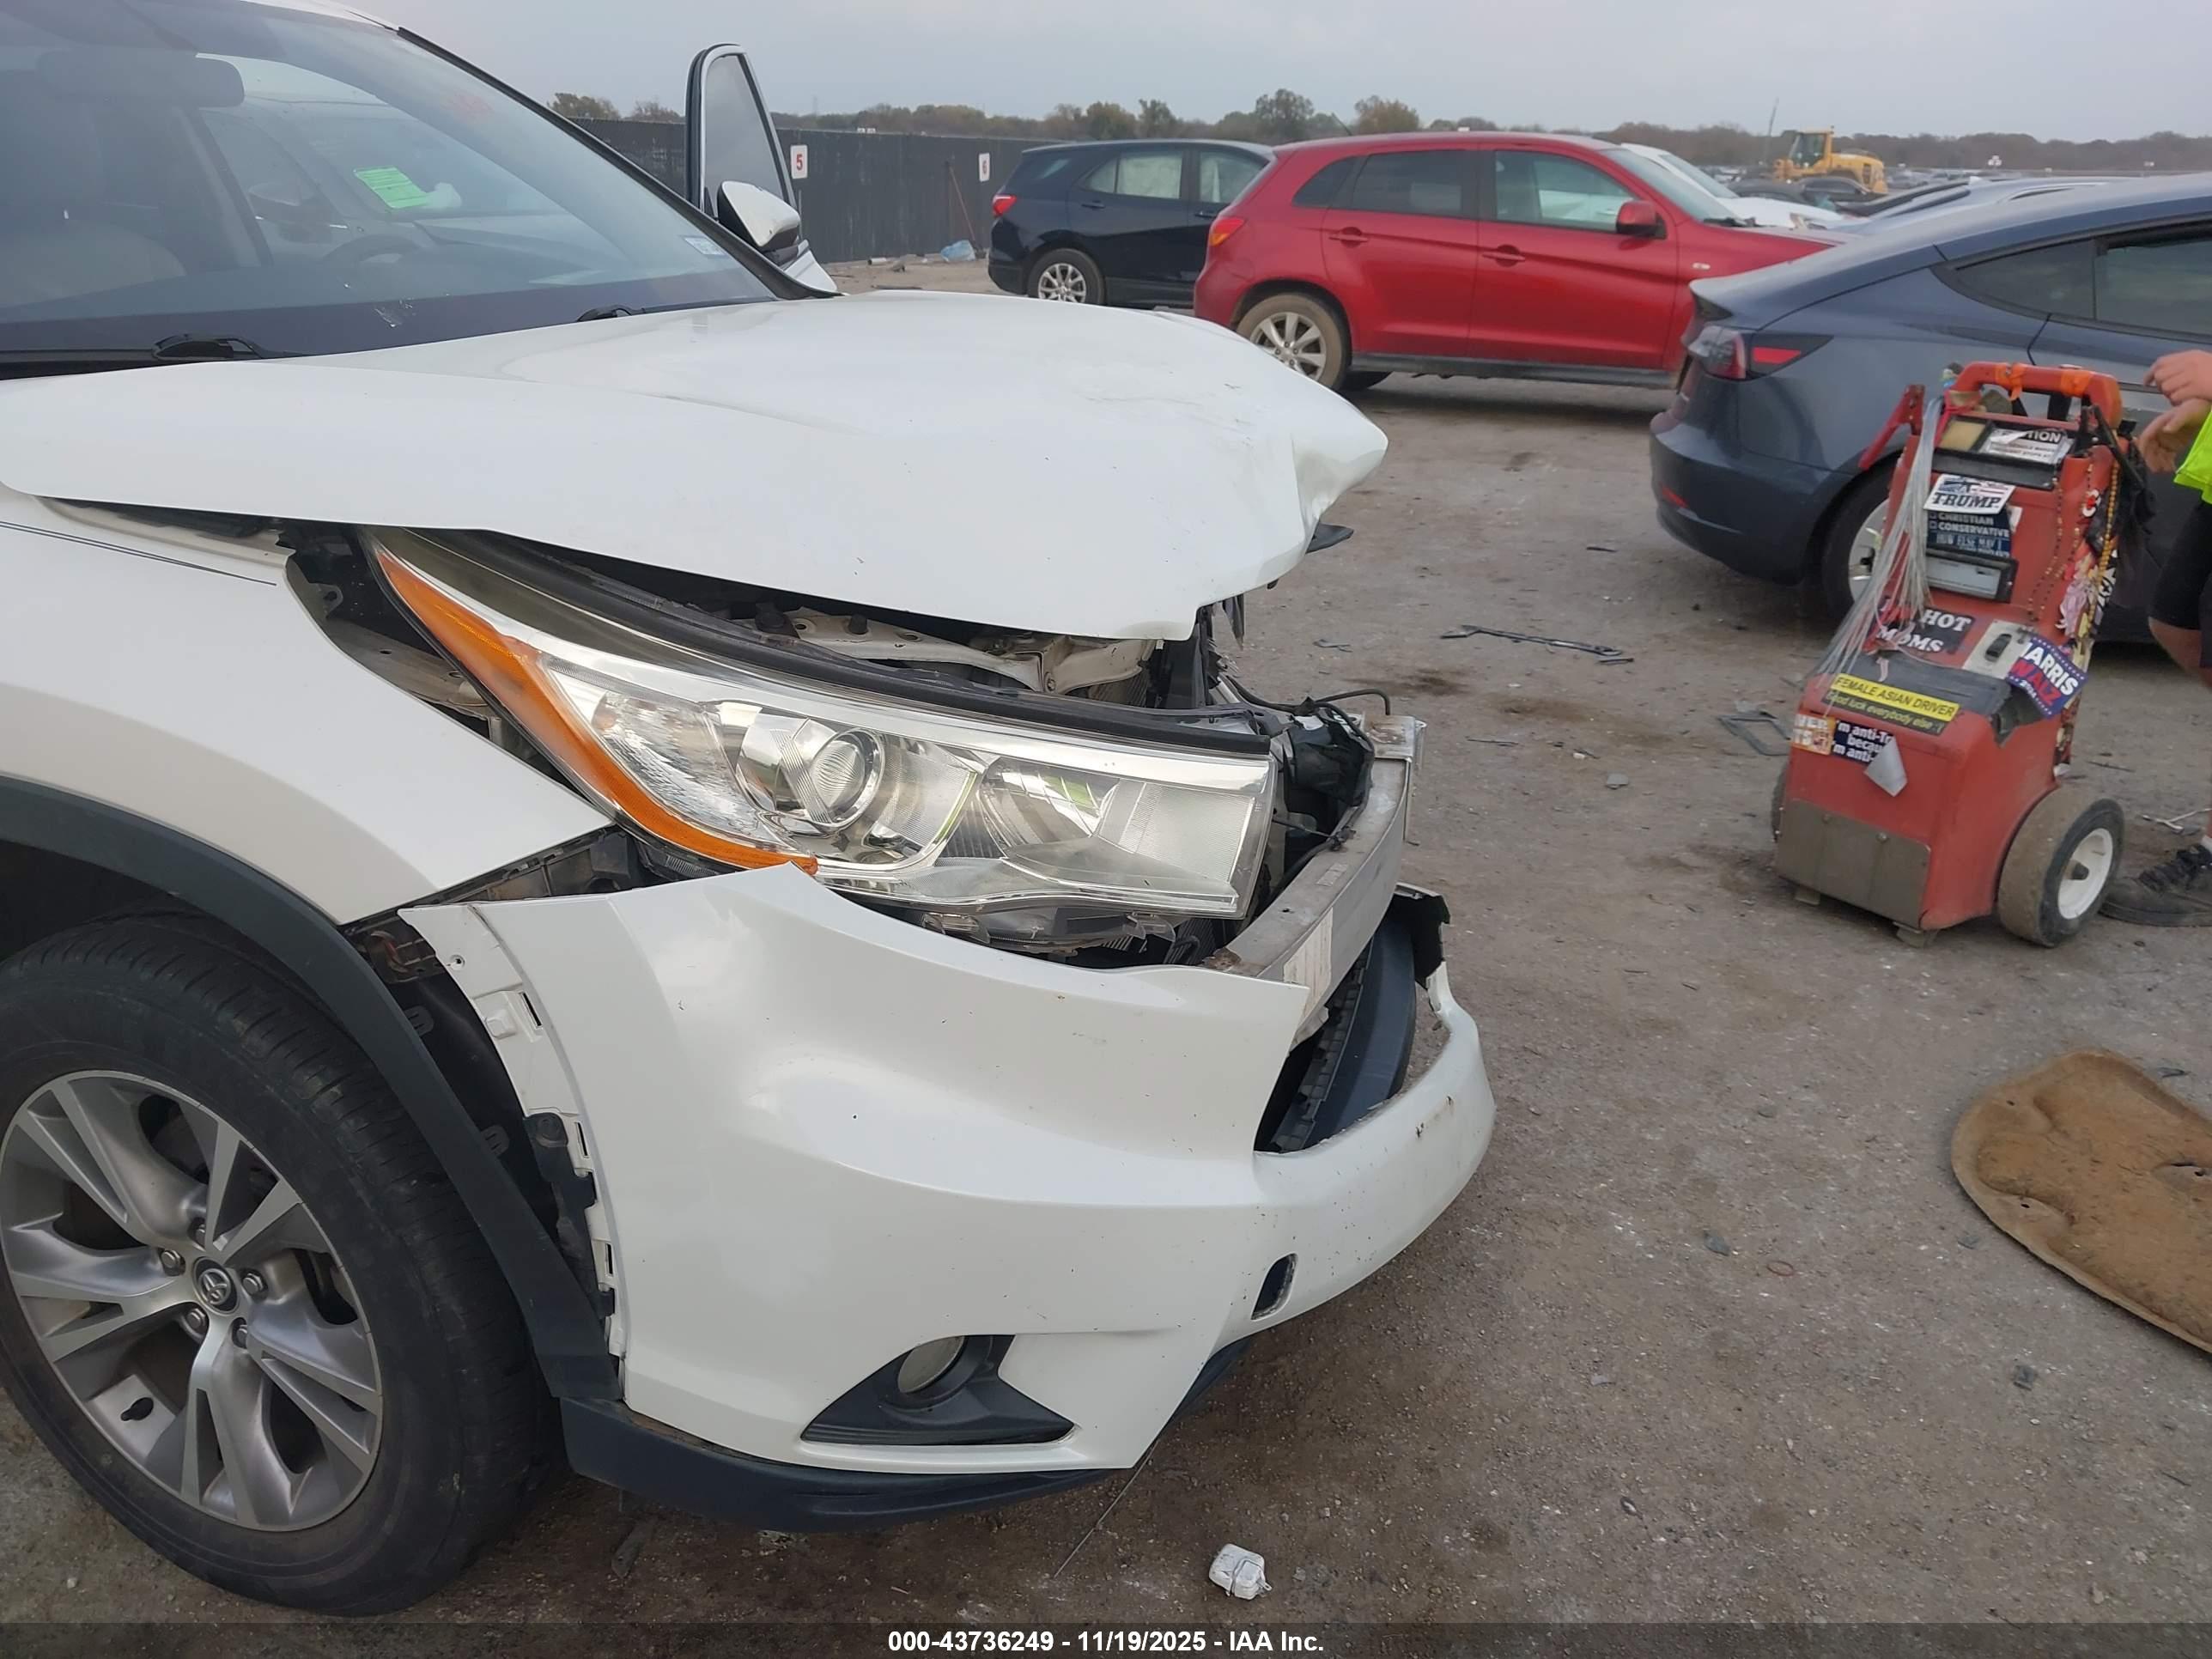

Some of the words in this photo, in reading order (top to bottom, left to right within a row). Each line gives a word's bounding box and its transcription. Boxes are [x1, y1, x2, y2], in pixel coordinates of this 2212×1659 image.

[796, 154, 803, 171] 5
[1933, 492, 2002, 508] TRUMP
[1938, 513, 1994, 526] CHRISTIAN
[1938, 521, 2009, 538] CONSERVATIVE
[1922, 610, 1972, 632] HOT
[1835, 677, 1877, 696] FEMALE
[1877, 689, 1912, 706] ASIAN
[1912, 698, 1956, 717] DRIVER
[1848, 696, 1867, 710] luck
[1868, 703, 1912, 726] everybody
[1912, 717, 1933, 730] else
[1847, 733, 1884, 752] becau
[1851, 725, 1894, 744] anti-Tr
